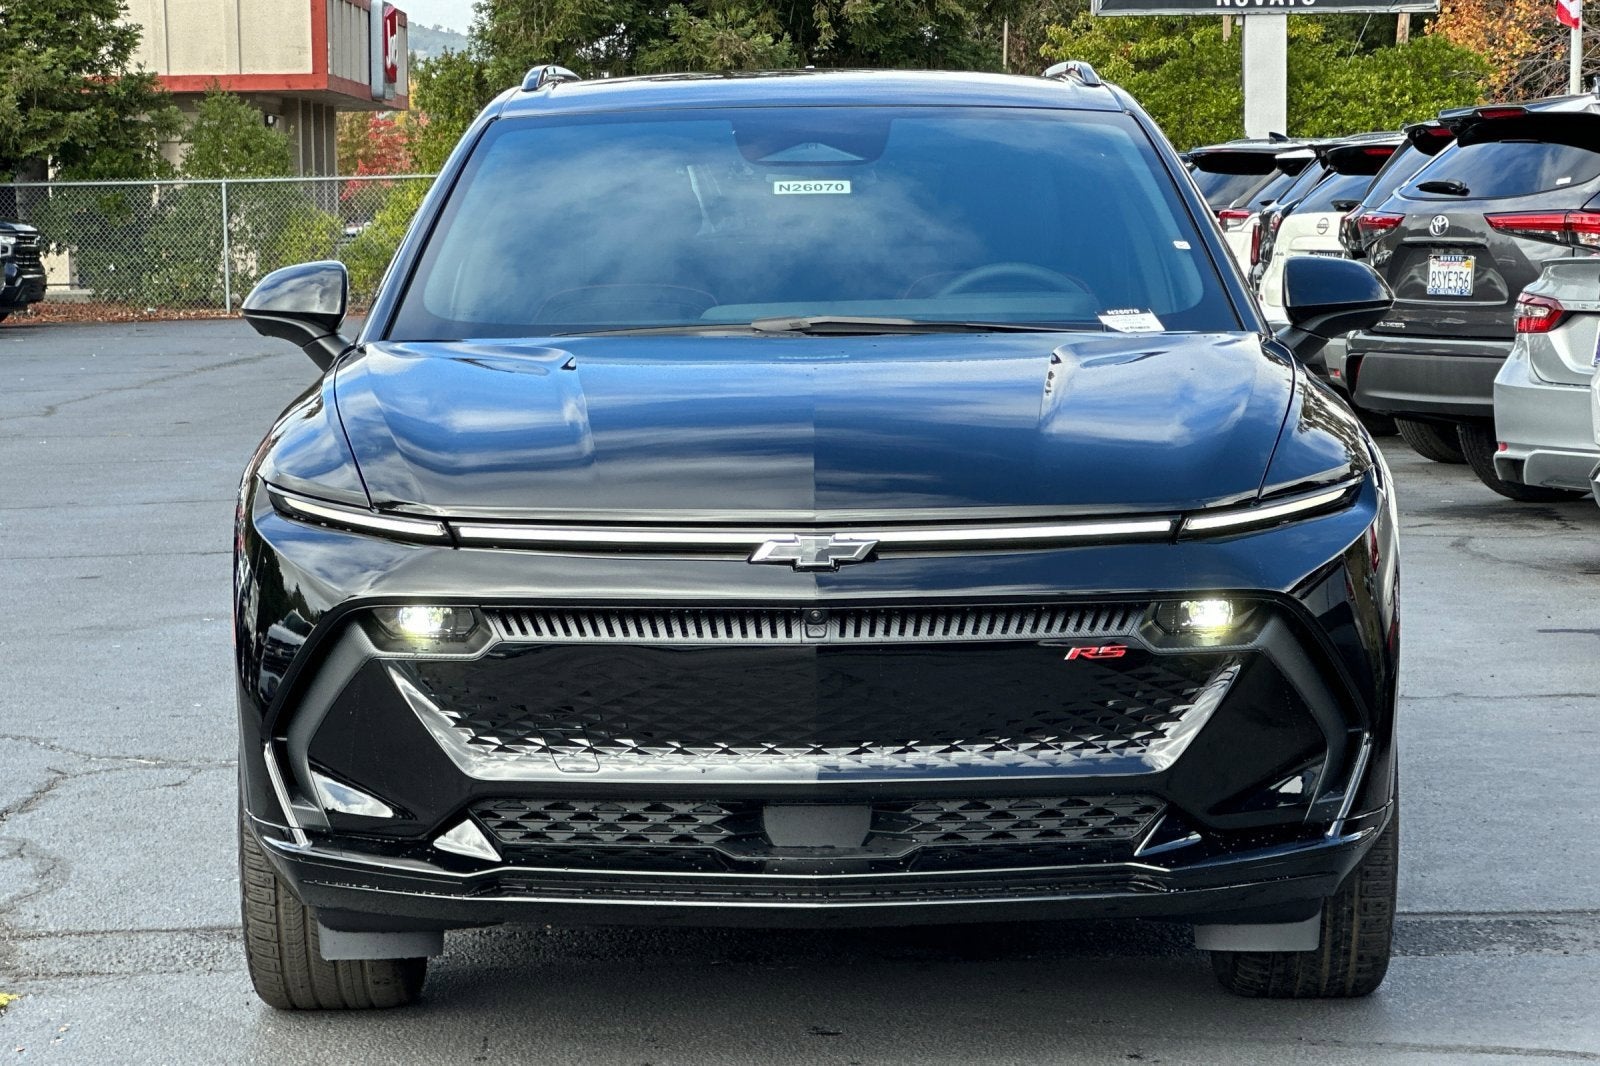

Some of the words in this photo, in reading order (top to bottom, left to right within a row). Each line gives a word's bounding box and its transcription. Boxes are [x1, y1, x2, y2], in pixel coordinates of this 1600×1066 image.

[778, 183, 844, 192] N26070
[1430, 271, 1470, 290] 8SYE356
[1064, 644, 1128, 660] RS
